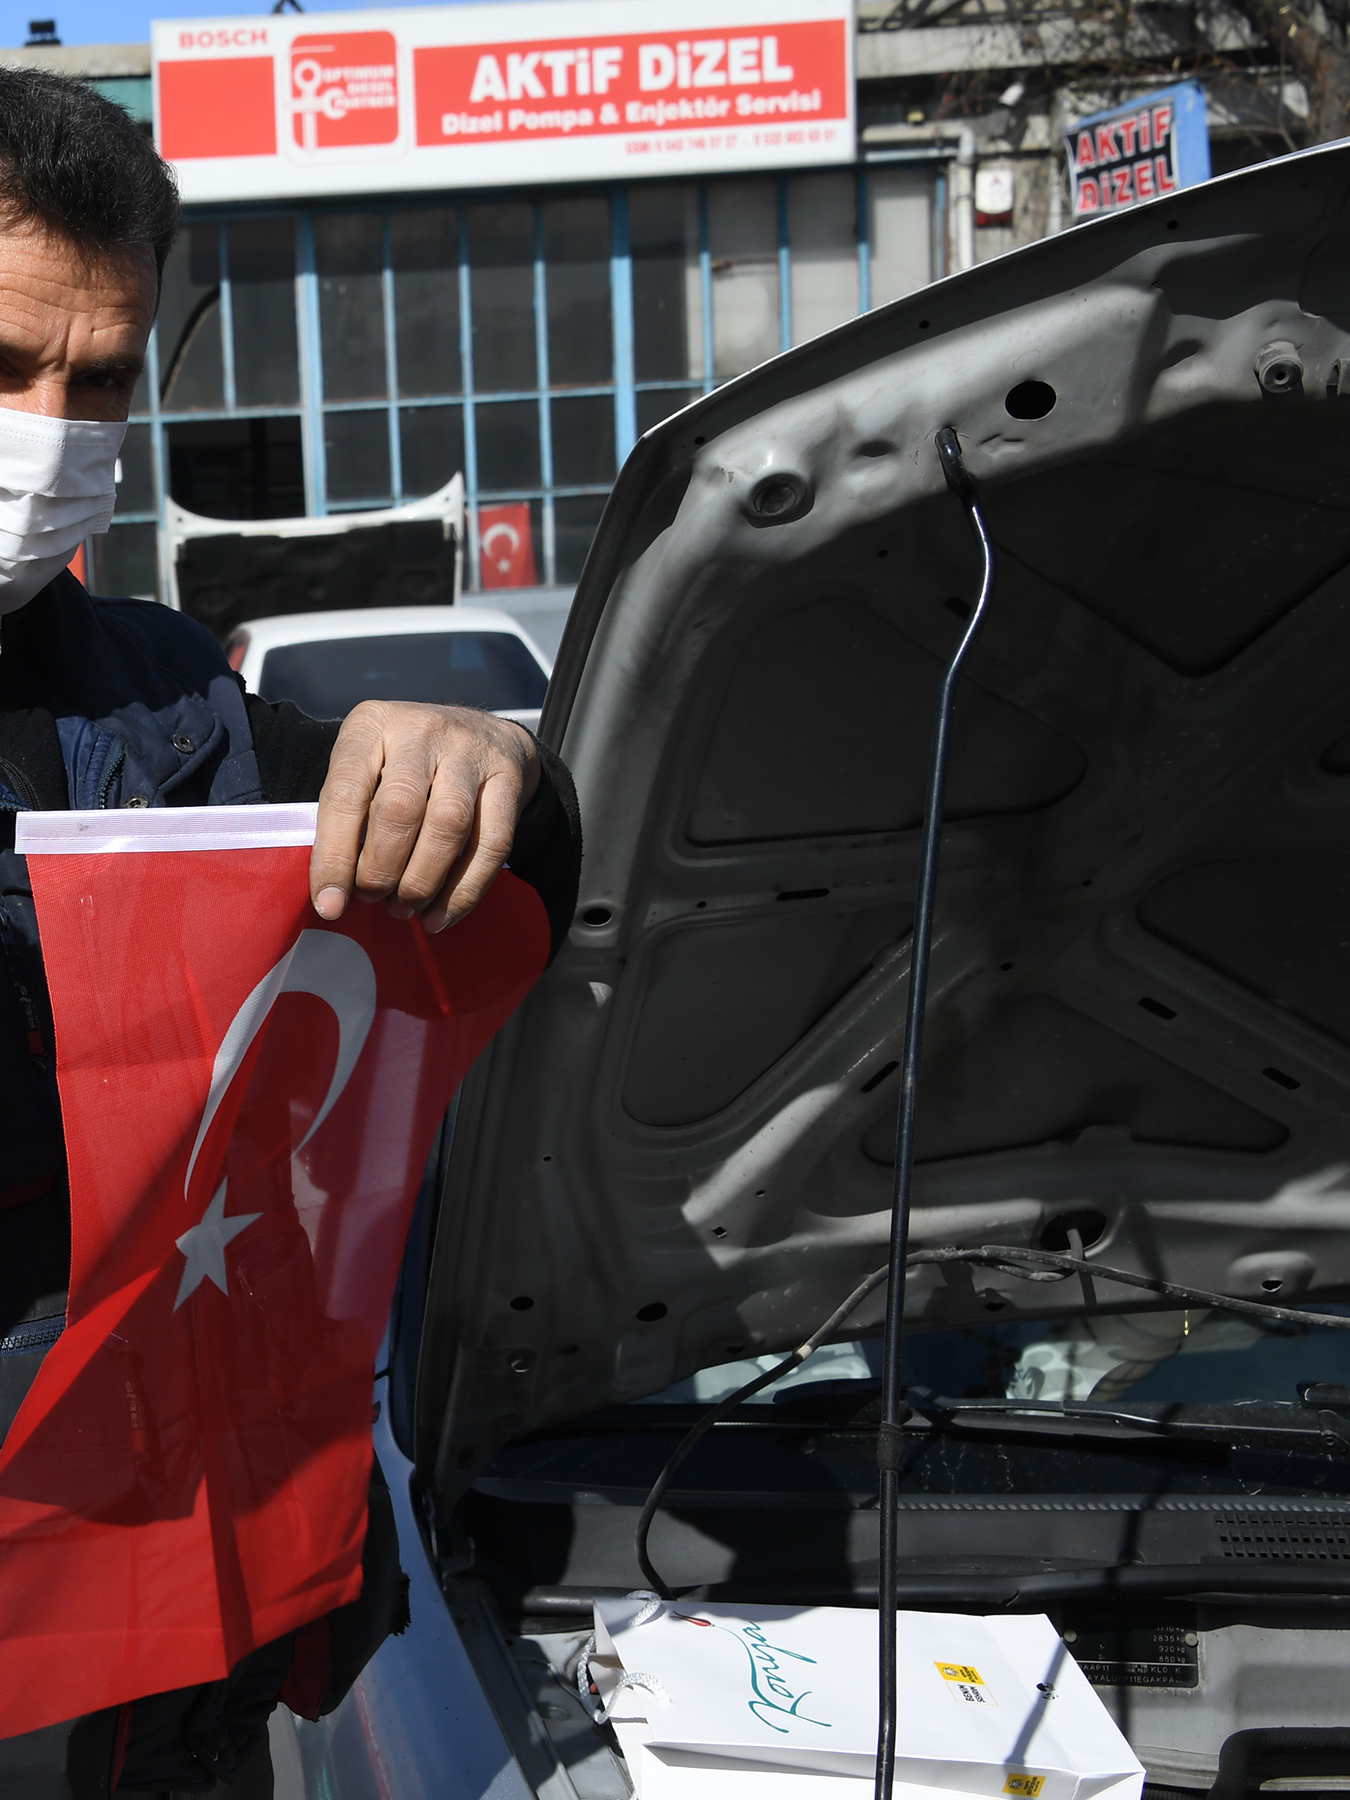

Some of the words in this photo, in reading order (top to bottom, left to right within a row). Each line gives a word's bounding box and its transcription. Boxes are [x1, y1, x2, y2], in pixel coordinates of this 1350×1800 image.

[179, 29, 268, 49] BOSCH
[442, 112, 503, 136] Dizel
[508, 104, 594, 133] Pompa
[599, 103, 621, 124] &
[625, 97, 731, 127] Enjektör
[735, 88, 822, 116] Servisi
[1176, 1646, 1185, 1654] kg
[1176, 1656, 1186, 1664] kg
